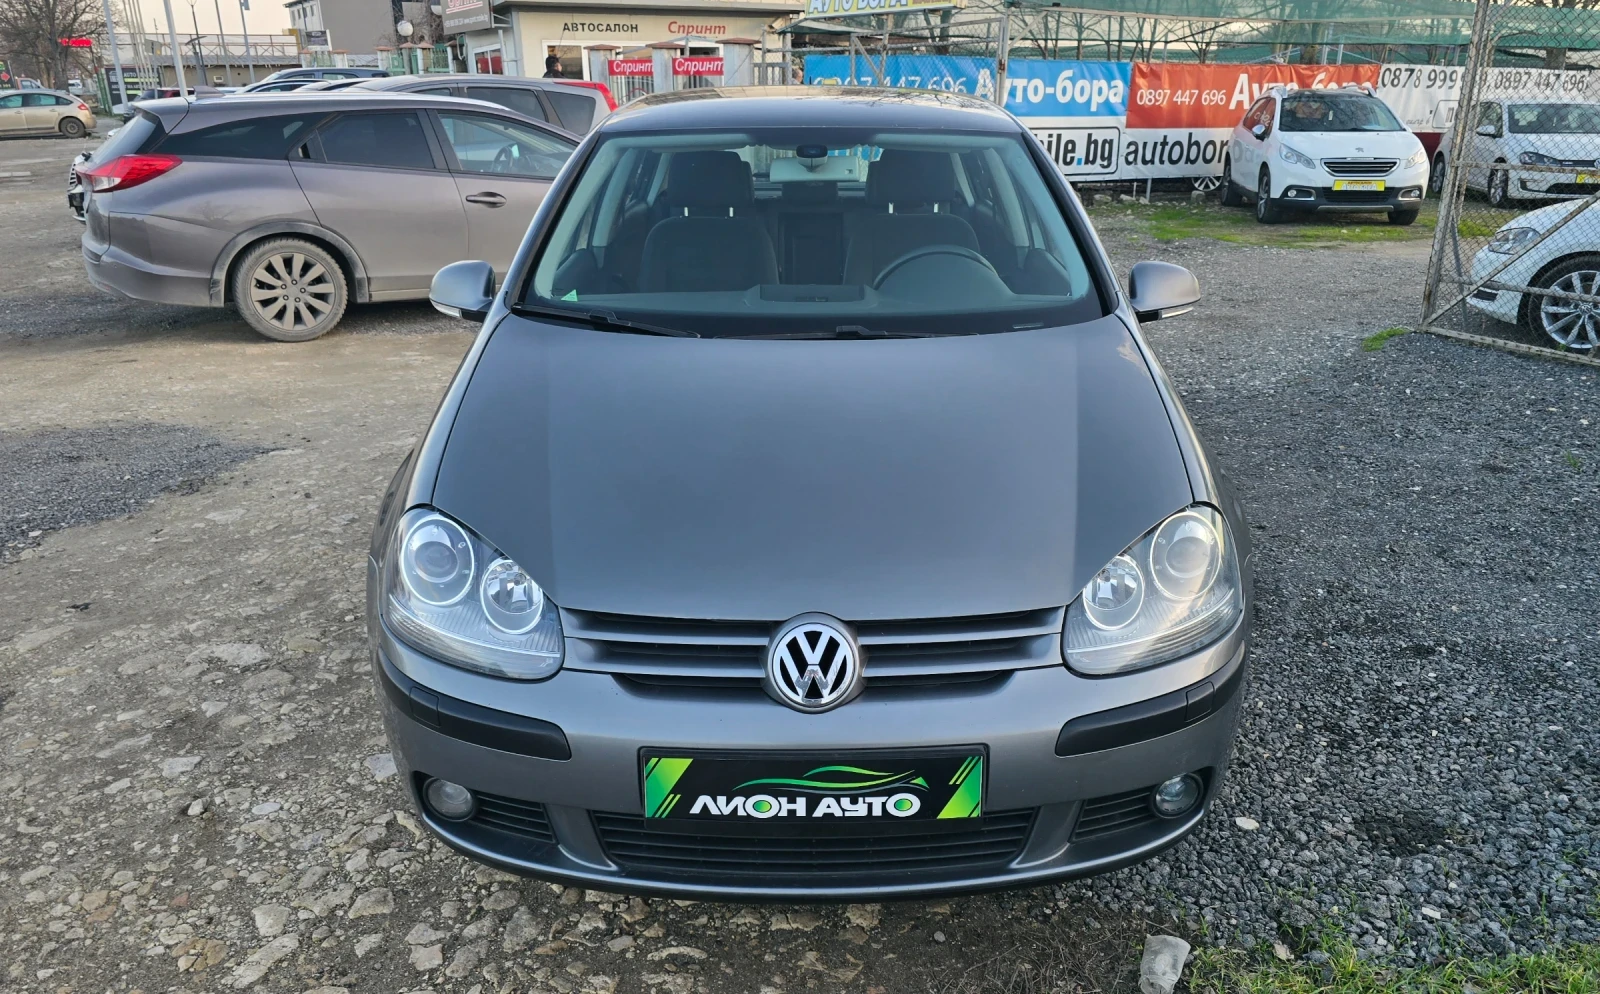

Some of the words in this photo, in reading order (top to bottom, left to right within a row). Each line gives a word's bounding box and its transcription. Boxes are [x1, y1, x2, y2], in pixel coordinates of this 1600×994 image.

[563, 22, 639, 33] АВТОСАЛОН
[668, 21, 727, 36] Спринт
[1381, 68, 1423, 89] 0878
[1136, 89, 1170, 106] 0897
[1172, 89, 1199, 106] 447
[1201, 89, 1226, 106] 696
[689, 794, 807, 819] ЛИОН
[811, 792, 921, 818] АУТО
